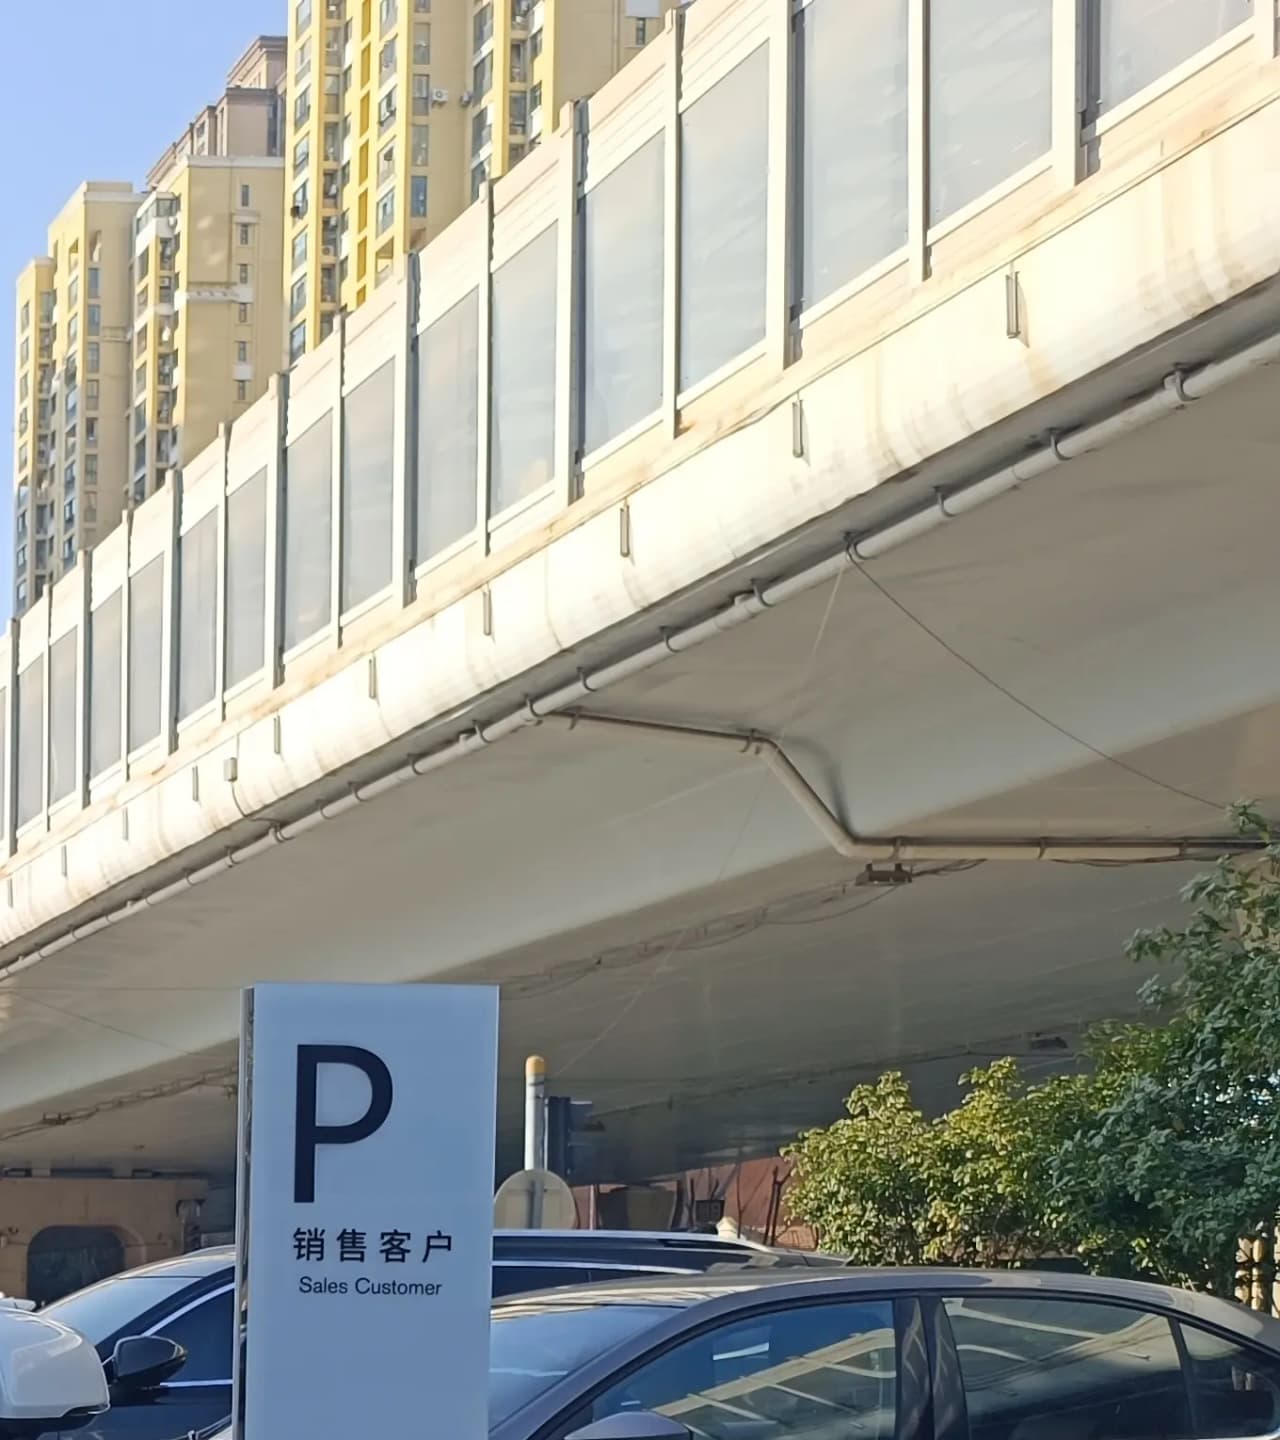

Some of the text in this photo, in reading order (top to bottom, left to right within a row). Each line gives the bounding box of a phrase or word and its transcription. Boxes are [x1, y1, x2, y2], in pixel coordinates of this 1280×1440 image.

[294, 1044, 393, 1203] P
[292, 1227, 452, 1263] 销售客户
[298, 1275, 443, 1296] Sales Customer
